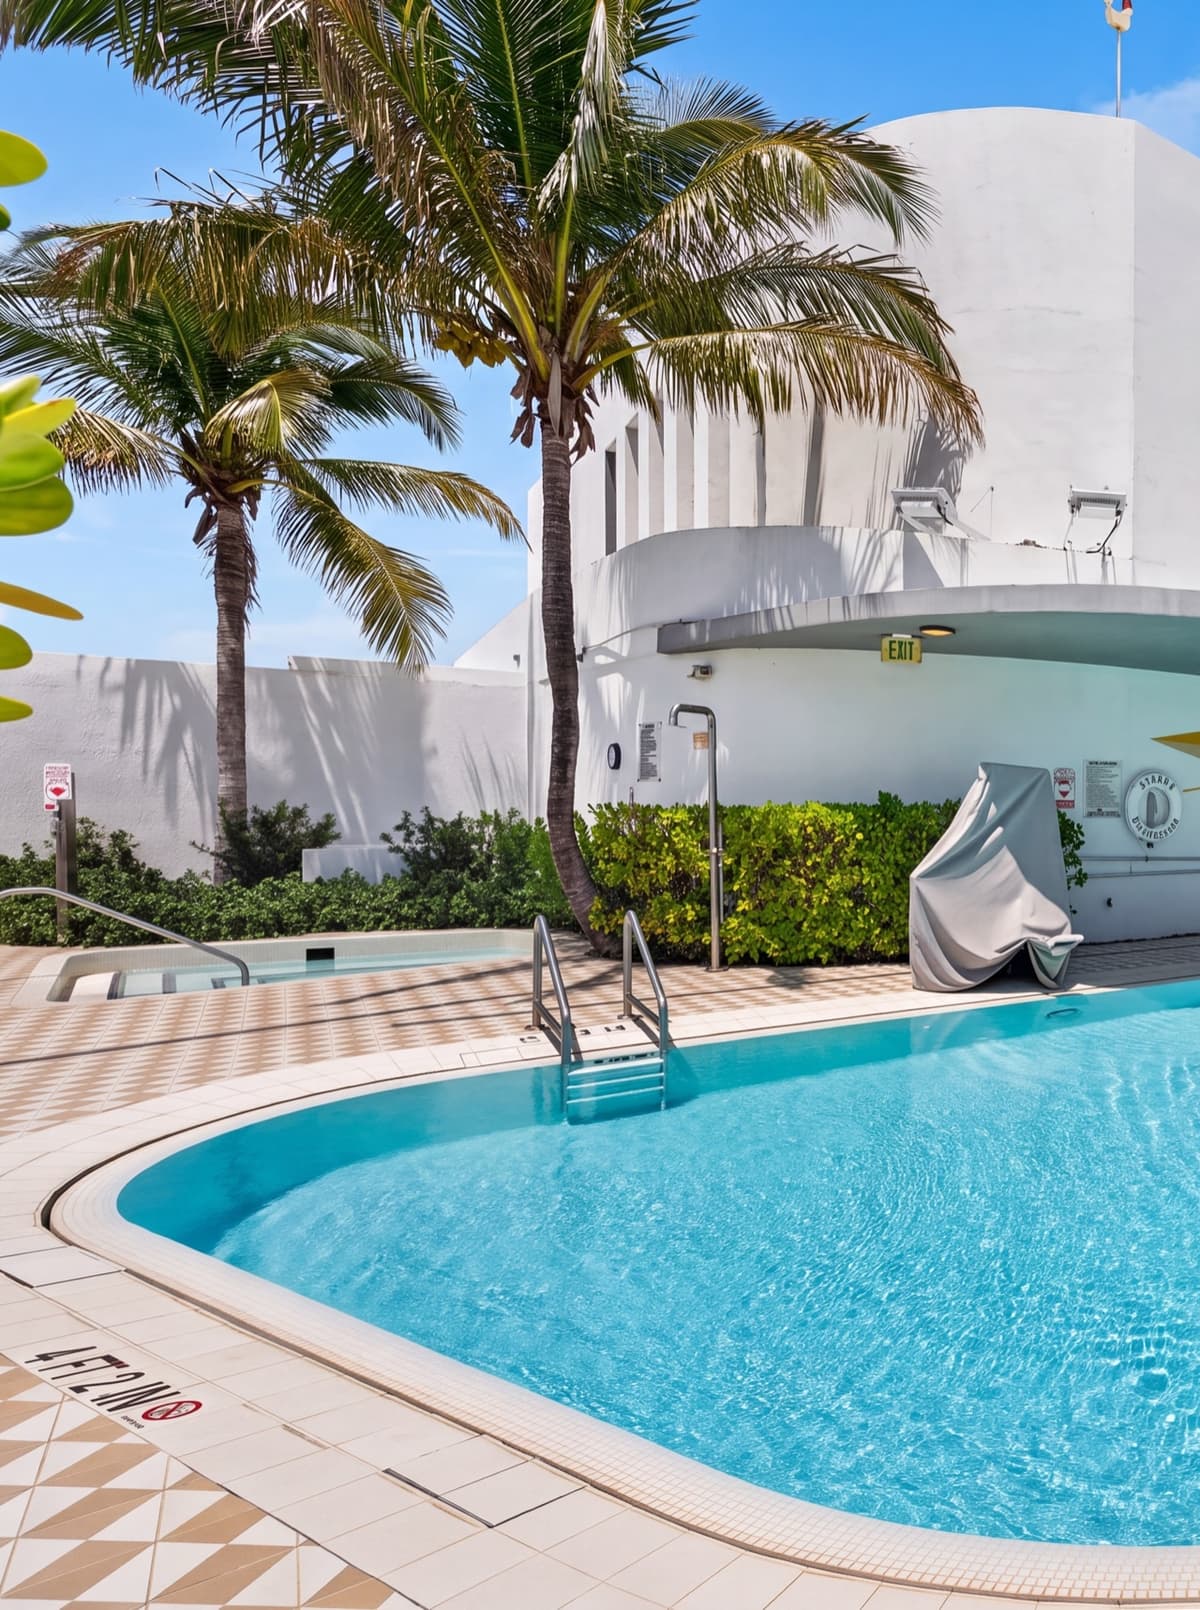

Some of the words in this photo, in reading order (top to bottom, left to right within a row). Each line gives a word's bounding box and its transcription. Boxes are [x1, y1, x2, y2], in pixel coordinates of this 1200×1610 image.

[888, 640, 914, 661] EXIT
[68, 1371, 145, 1394] 2
[90, 1381, 181, 1412] IN
